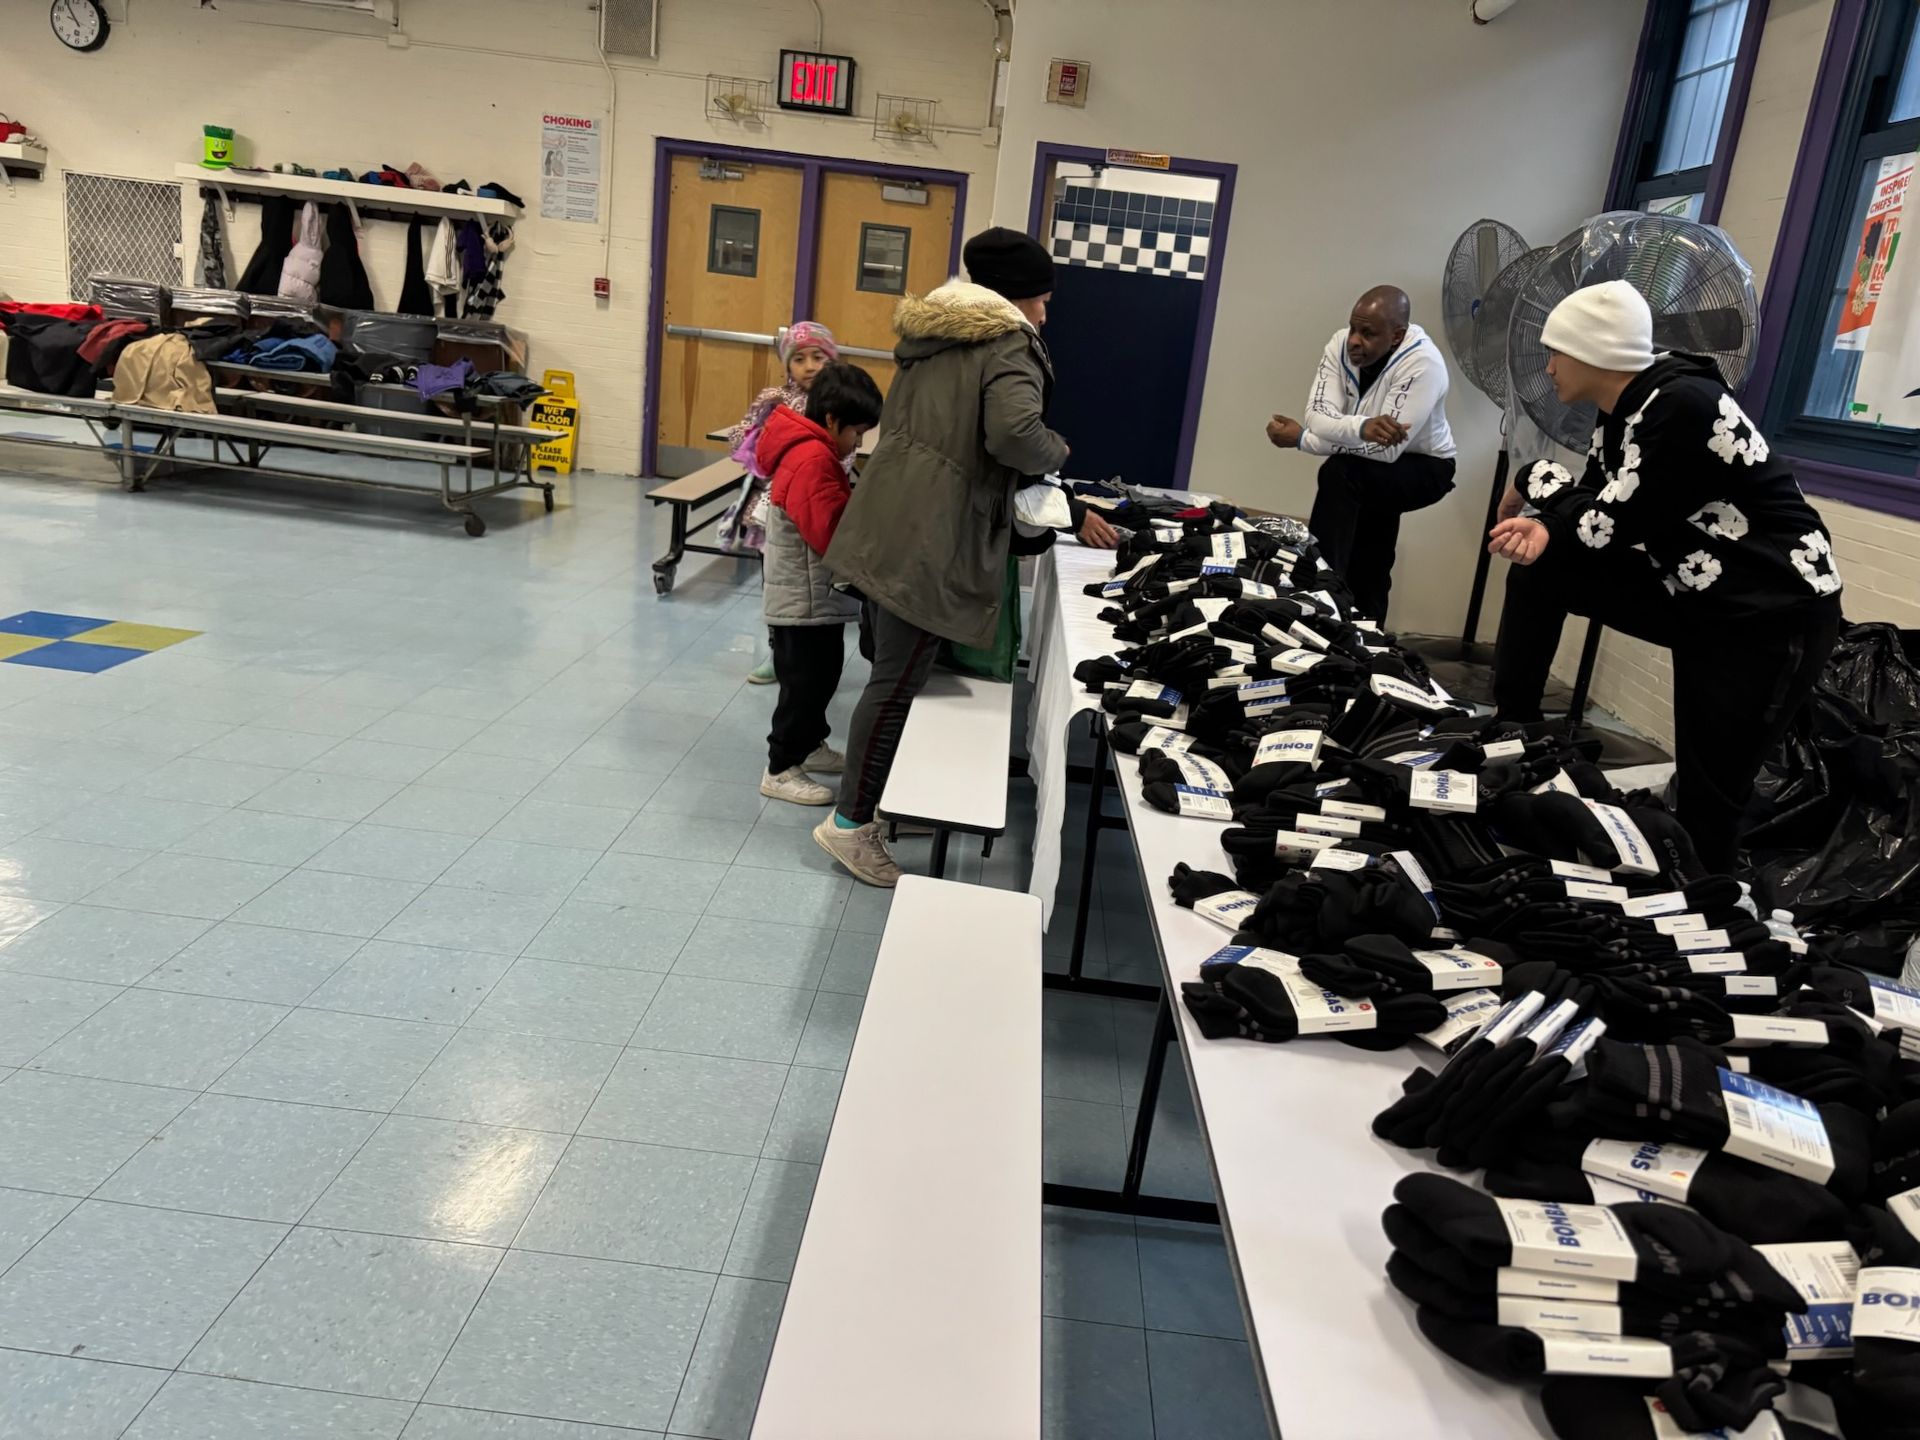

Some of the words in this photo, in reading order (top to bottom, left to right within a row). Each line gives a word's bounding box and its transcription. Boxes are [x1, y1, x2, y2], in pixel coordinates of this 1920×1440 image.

[792, 61, 838, 104] EXIT
[543, 115, 592, 128] CHOKING
[1870, 196, 1892, 213] CHEFS
[543, 405, 567, 416] WET
[536, 413, 570, 425] FLOOR
[538, 452, 569, 463] CAREFUL
[1447, 999, 1501, 1019] MBAS
[1541, 1201, 1581, 1247] BOMBA
